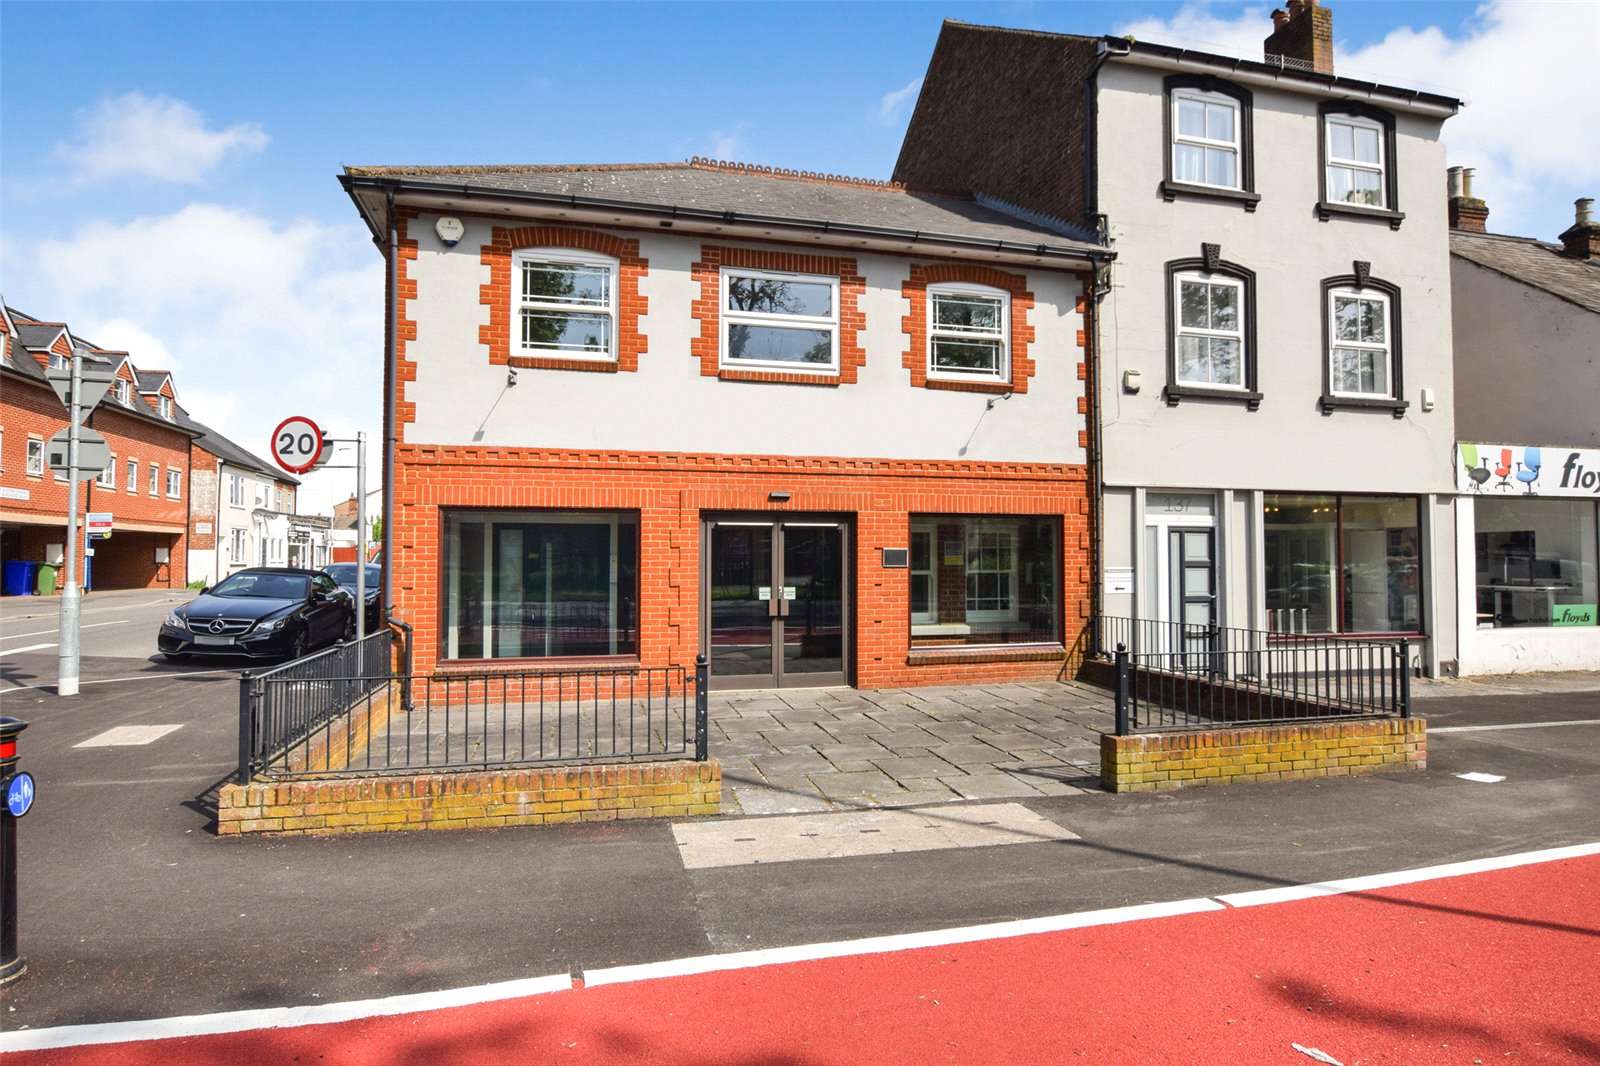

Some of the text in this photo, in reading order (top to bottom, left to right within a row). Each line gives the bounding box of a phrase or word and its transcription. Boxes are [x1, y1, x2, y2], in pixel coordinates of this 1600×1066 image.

[279, 433, 314, 455] 20
[1164, 496, 1191, 512] 137
[1561, 608, 1591, 624] floyds
